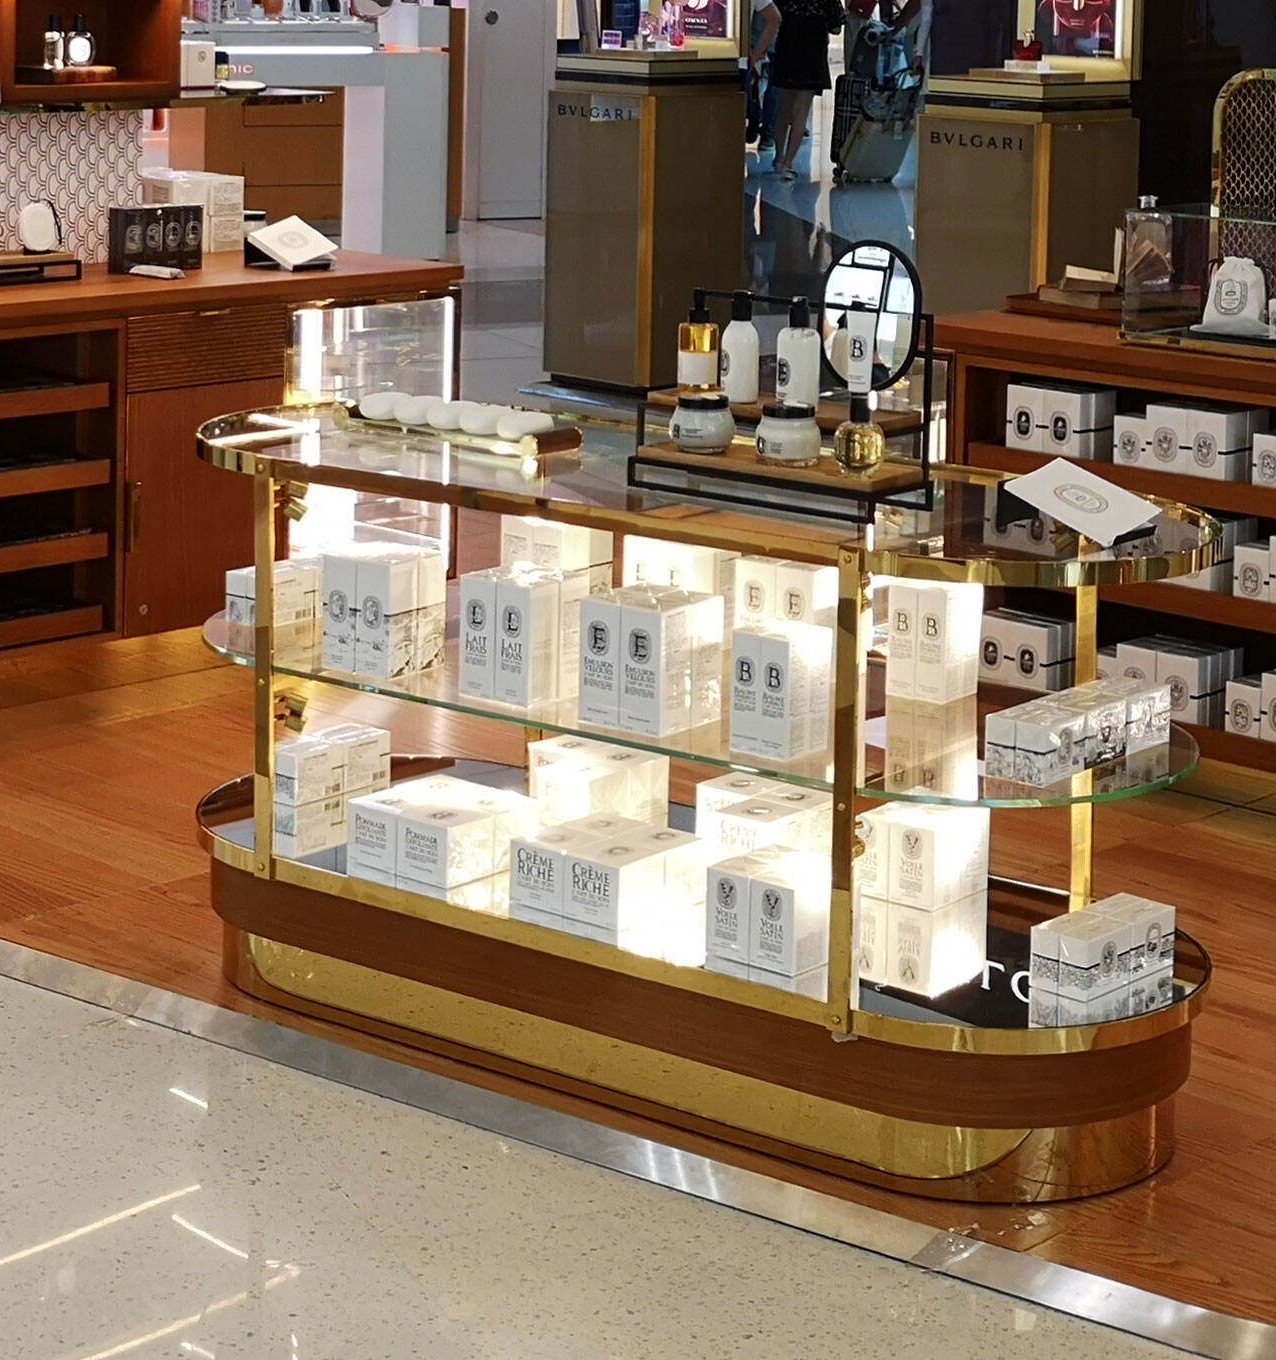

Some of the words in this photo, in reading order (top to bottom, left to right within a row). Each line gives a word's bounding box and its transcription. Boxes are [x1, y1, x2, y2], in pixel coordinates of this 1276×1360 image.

[557, 103, 633, 121] BVLGARI
[930, 131, 1023, 151] BVLGARI
[517, 847, 555, 869] CRÈME
[517, 859, 555, 882] RICHE
[572, 862, 610, 885] CRÈME
[572, 874, 610, 897] RICHE
